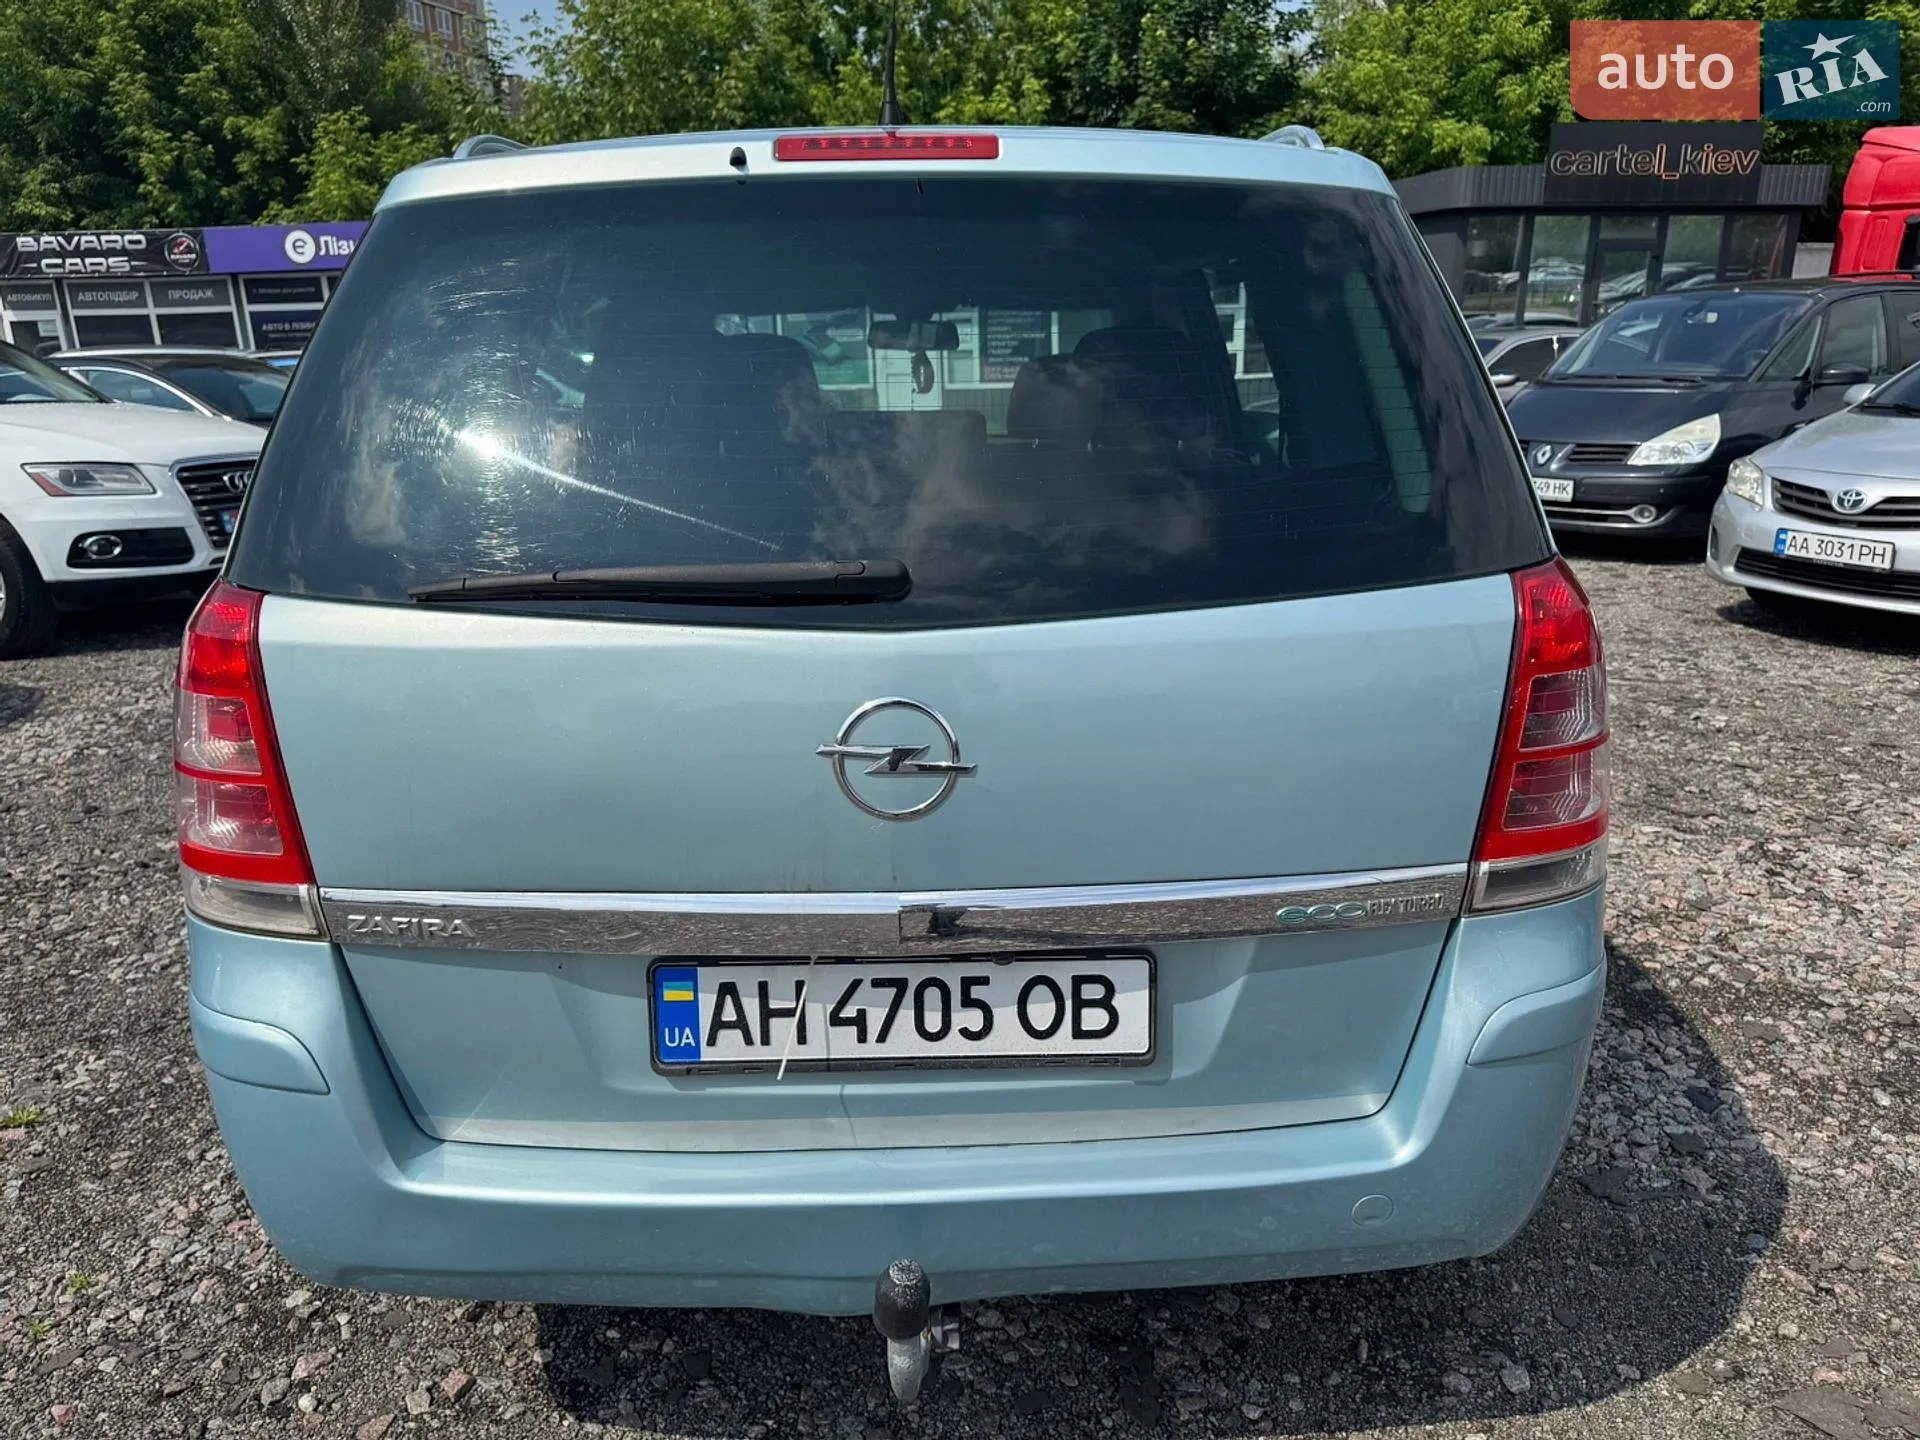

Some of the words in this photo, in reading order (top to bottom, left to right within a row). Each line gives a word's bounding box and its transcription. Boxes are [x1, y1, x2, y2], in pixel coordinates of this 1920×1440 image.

[1550, 143, 1760, 179] cartel_kiev
[16, 235, 147, 252] BAVARO
[41, 256, 131, 273] CARS
[78, 290, 139, 302] АВТОПІДБІР
[167, 289, 214, 300] ПРОДАЖ
[1553, 482, 1571, 496] HK
[1787, 535, 1809, 554] AA
[1814, 539, 1854, 561] 3031
[1858, 544, 1887, 564] PH
[346, 914, 476, 938] ZAFIRA
[705, 980, 807, 1047] AH
[829, 975, 994, 1044] 4705
[1018, 974, 1119, 1041] OB
[664, 1027, 696, 1047] UA
